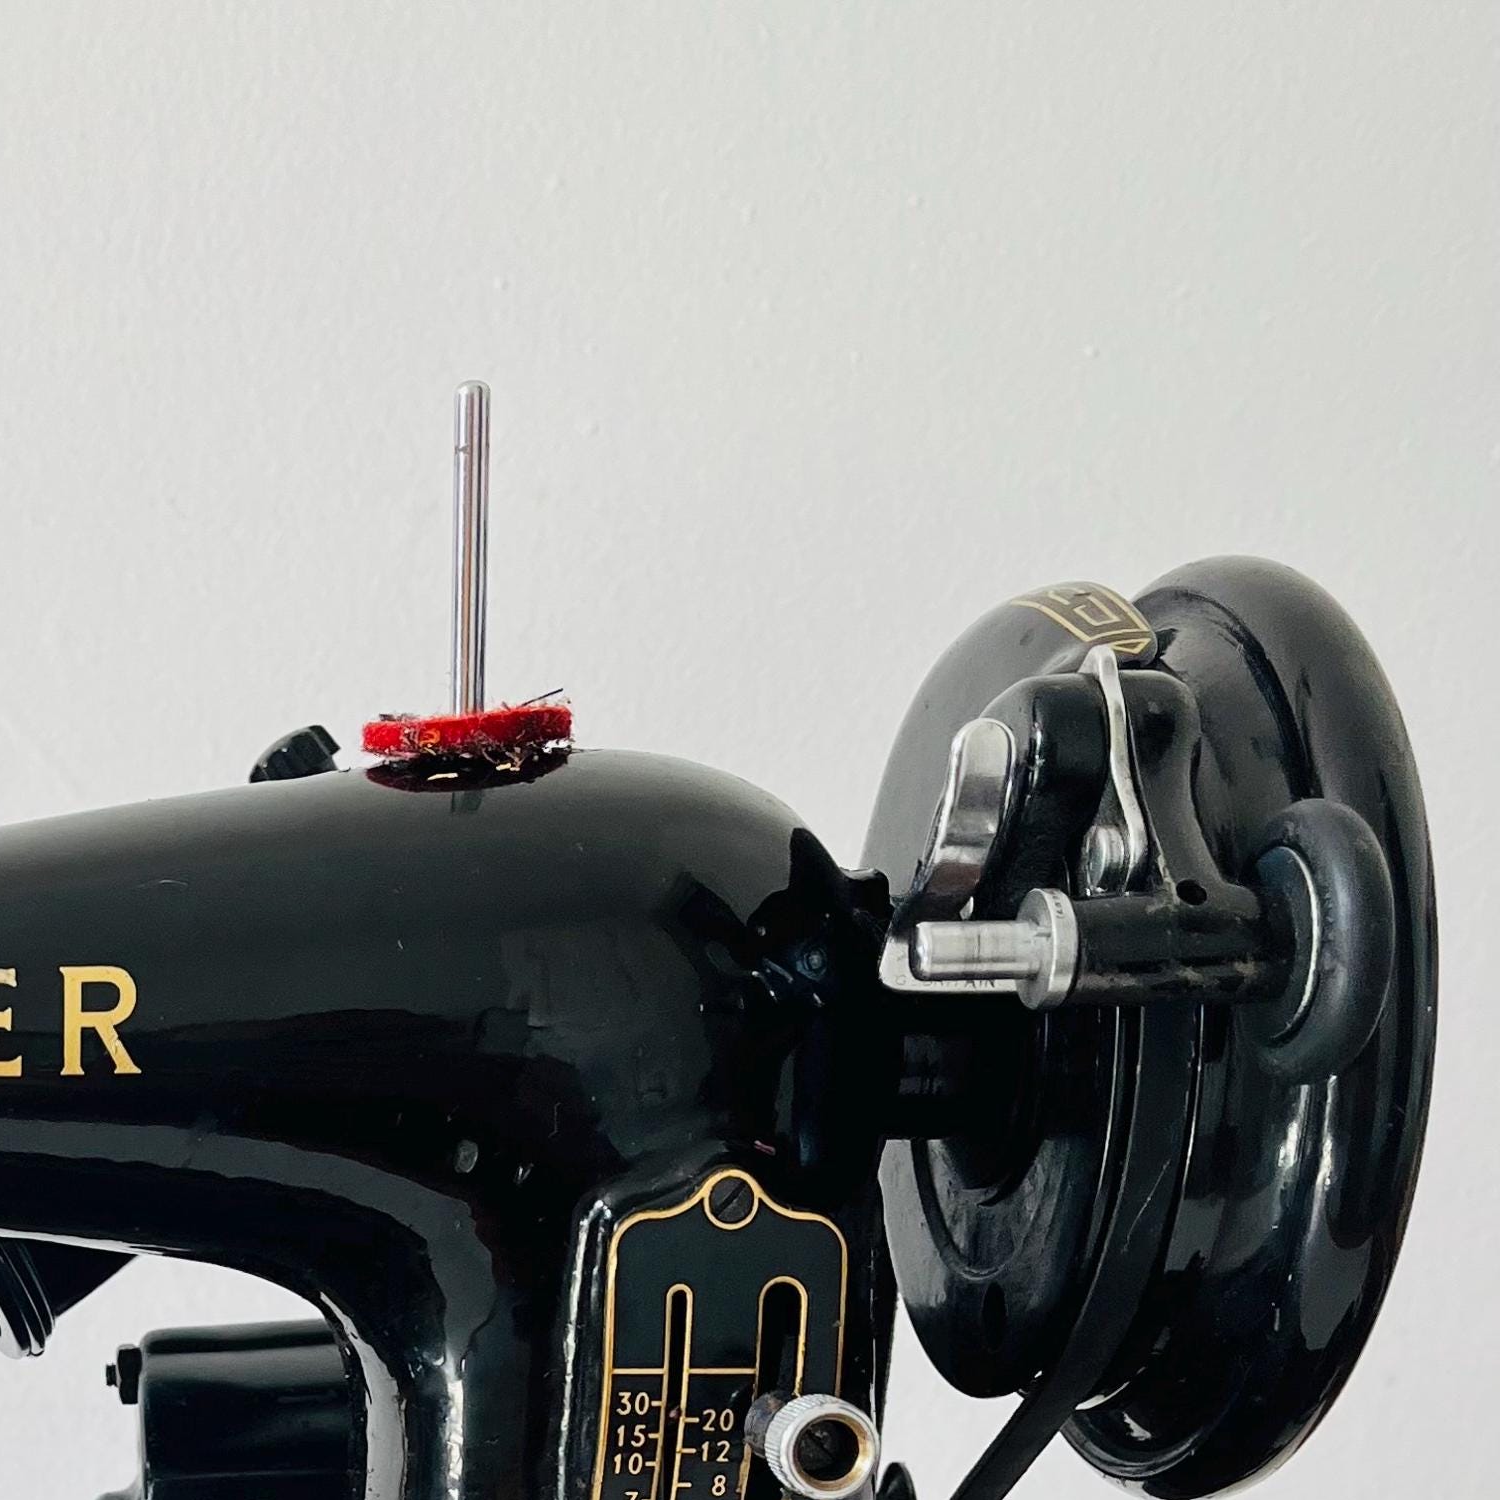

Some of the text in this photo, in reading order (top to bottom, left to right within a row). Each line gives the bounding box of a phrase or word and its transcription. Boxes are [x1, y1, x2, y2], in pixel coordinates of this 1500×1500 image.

[617, 1392, 649, 1415] 30
[702, 1409, 734, 1432] 20
[617, 1425, 646, 1447] 15
[702, 1440, 731, 1463] 12
[613, 1452, 643, 1475] 10
[711, 1474, 726, 1496] 8
